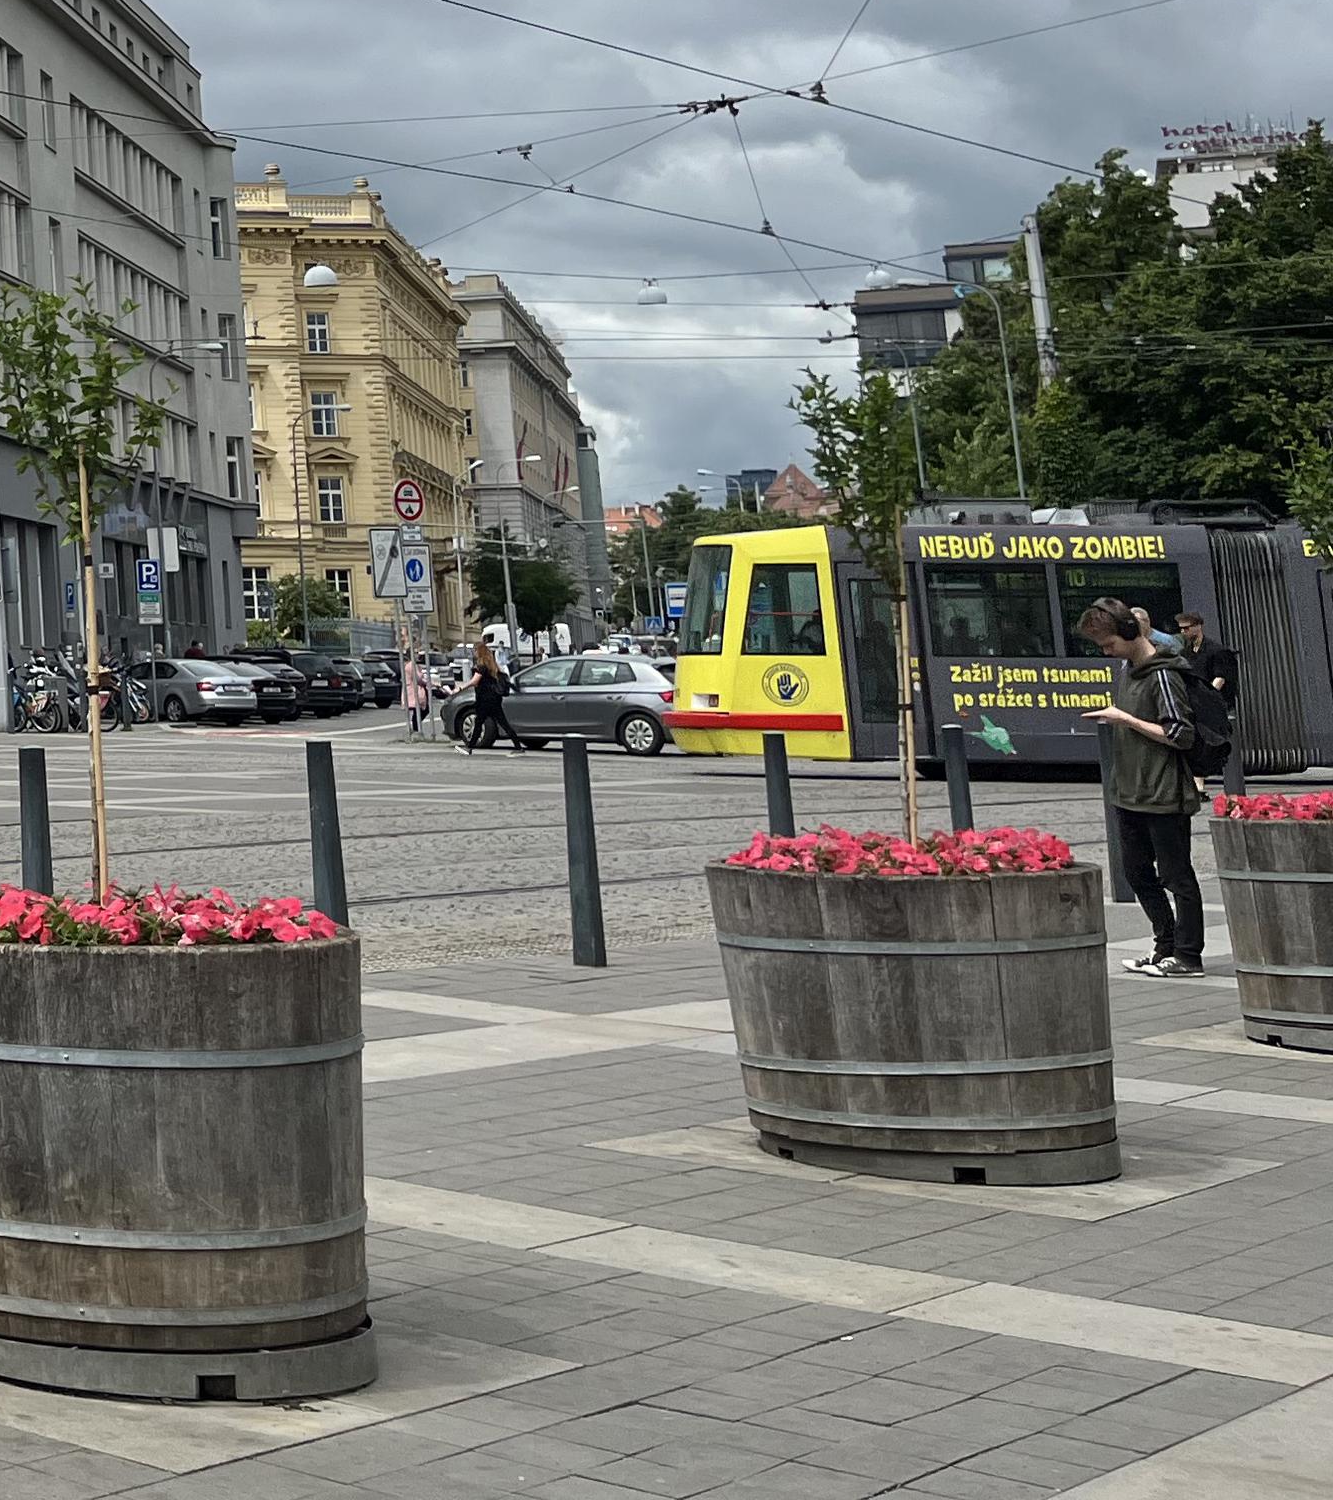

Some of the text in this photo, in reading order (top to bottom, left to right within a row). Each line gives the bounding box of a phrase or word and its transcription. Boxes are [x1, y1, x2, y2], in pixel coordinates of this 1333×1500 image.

[1160, 119, 1236, 137] hotel
[918, 532, 1166, 560] NEBUĎ JAKO ZOMBIE!
[142, 563, 156, 582] P
[949, 662, 1113, 688] Zažil jsem tsunami
[953, 687, 1112, 712] po srážce s tunami
